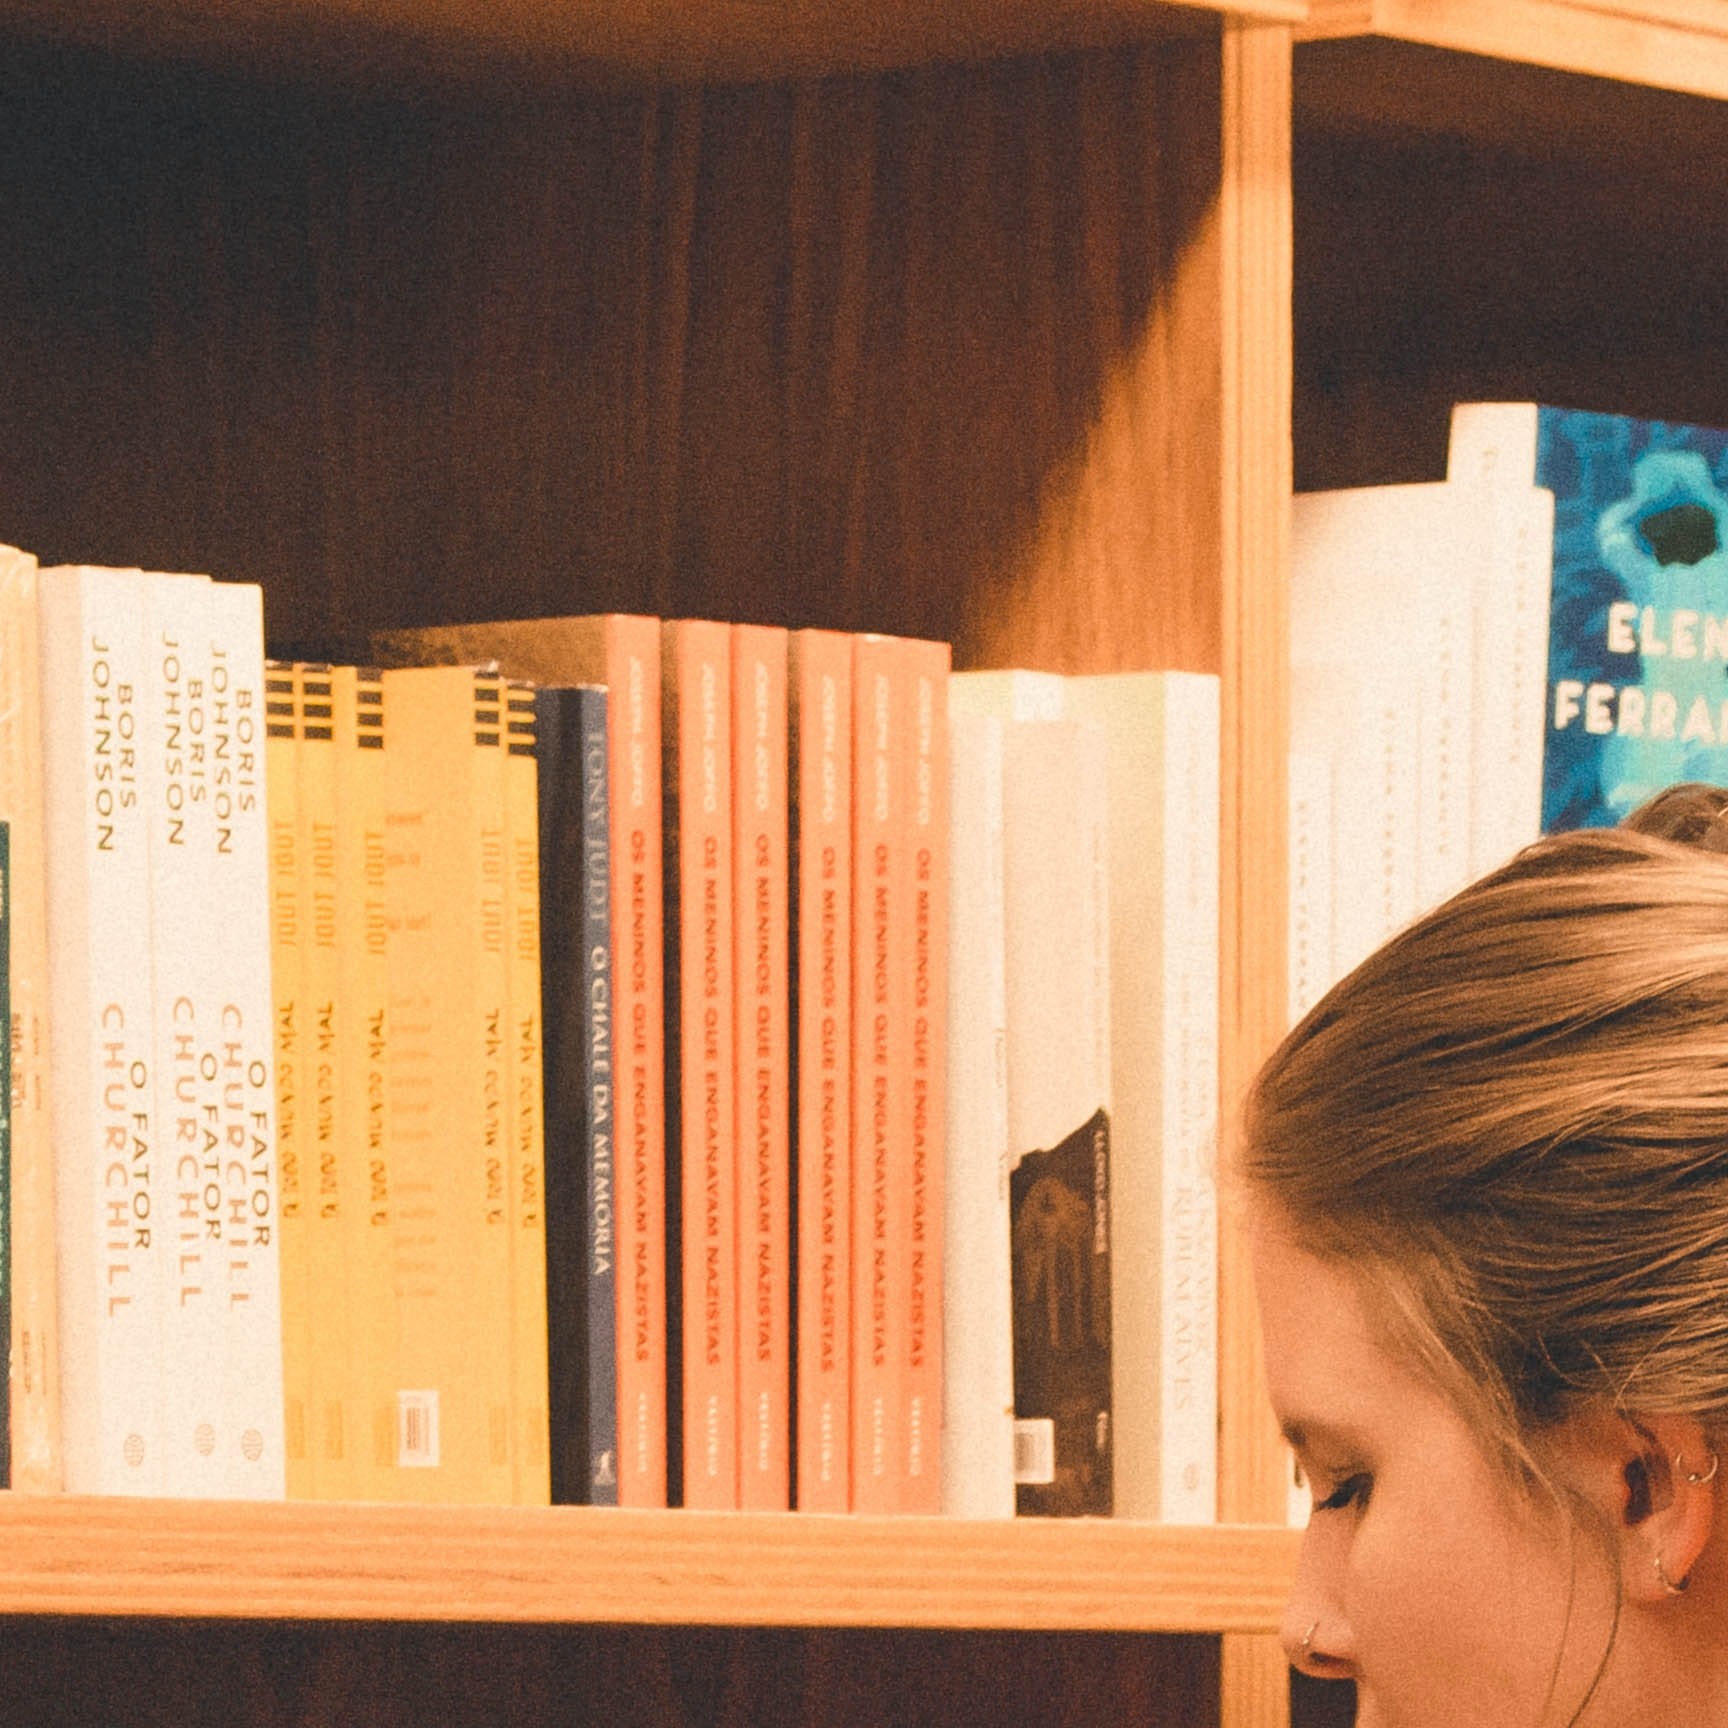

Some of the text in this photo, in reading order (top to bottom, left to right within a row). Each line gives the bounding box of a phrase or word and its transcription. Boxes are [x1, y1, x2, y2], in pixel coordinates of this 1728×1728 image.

[92, 635, 112, 850] JOHNSON
[117, 684, 135, 807] BORIS
[162, 631, 183, 845] JOHNSON
[188, 679, 205, 801] BORIS
[211, 640, 231, 853] JOHNSON
[236, 689, 254, 810] BORIS
[101, 1003, 131, 1316] CHURCHILL
[130, 1061, 150, 1248] O FATOR
[173, 996, 201, 1305] CHURCHILL
[200, 1052, 221, 1239] O FATOR
[222, 1004, 247, 1308] CHURCHILL
[248, 1060, 269, 1245] O FATOR
